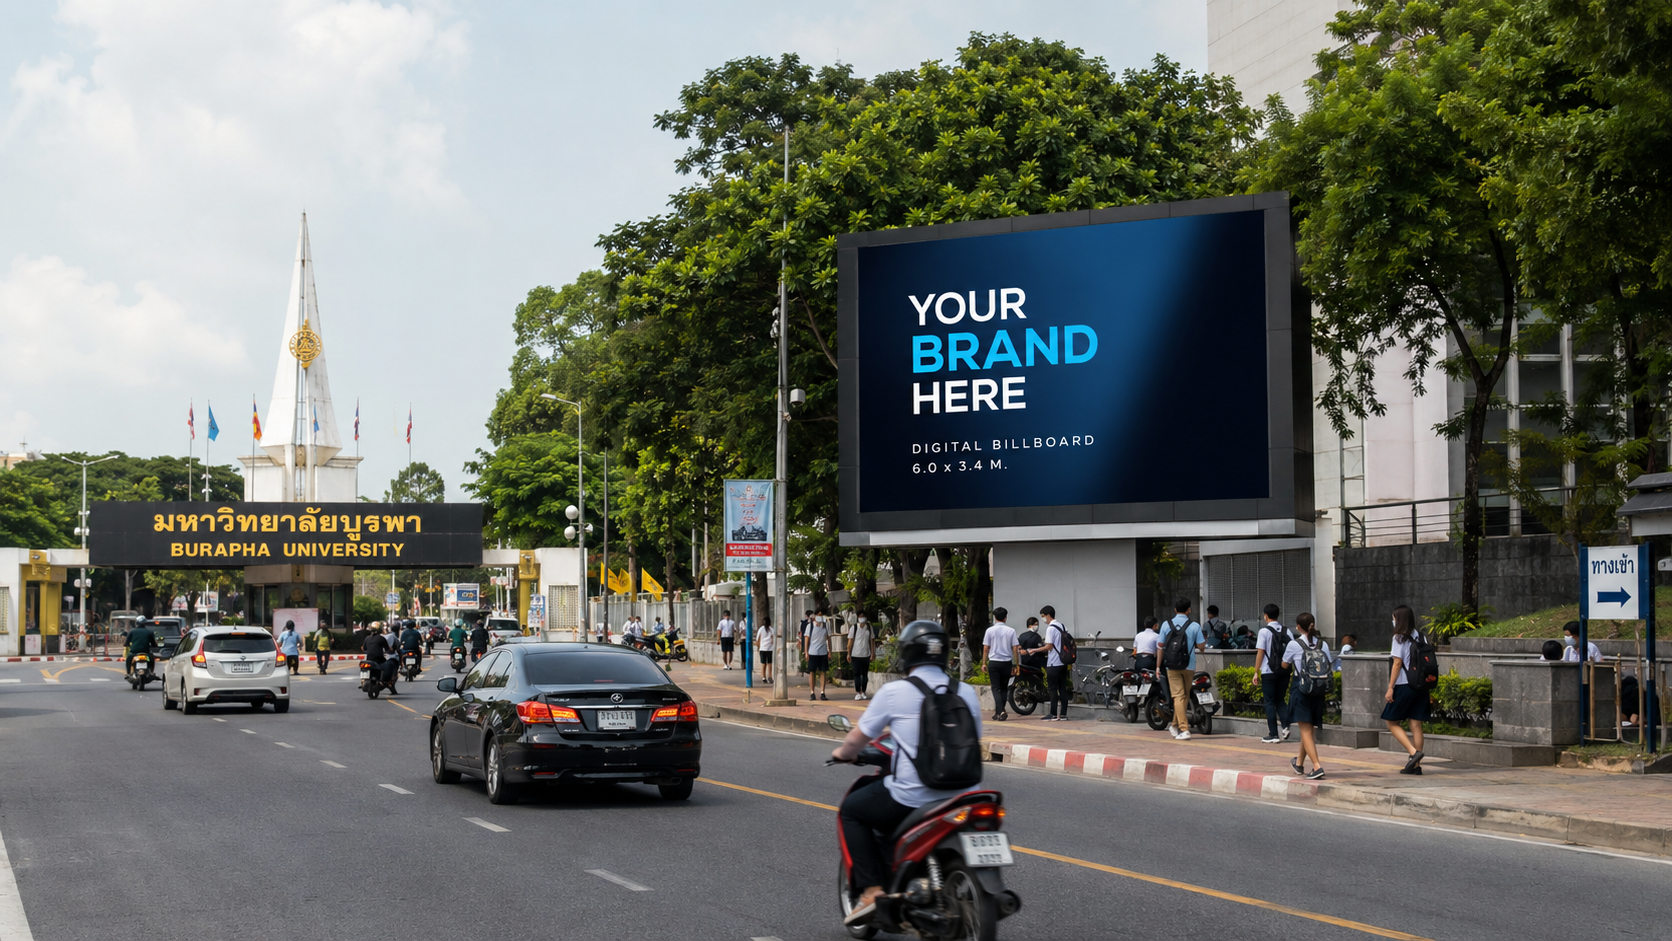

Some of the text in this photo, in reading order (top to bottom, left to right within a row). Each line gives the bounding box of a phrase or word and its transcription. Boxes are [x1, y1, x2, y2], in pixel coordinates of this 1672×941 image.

[907, 287, 1027, 326] YOUR
[912, 324, 1099, 374] BRAND
[912, 376, 1027, 415] HERE
[912, 435, 1095, 454] DIGITAL BILLBOARD
[912, 459, 1008, 474] 6.0 x 3.4 M.
[153, 506, 422, 541] มหาวิทยาลัยบูรพา
[170, 542, 405, 557] BURAPHA UNIVERSITY
